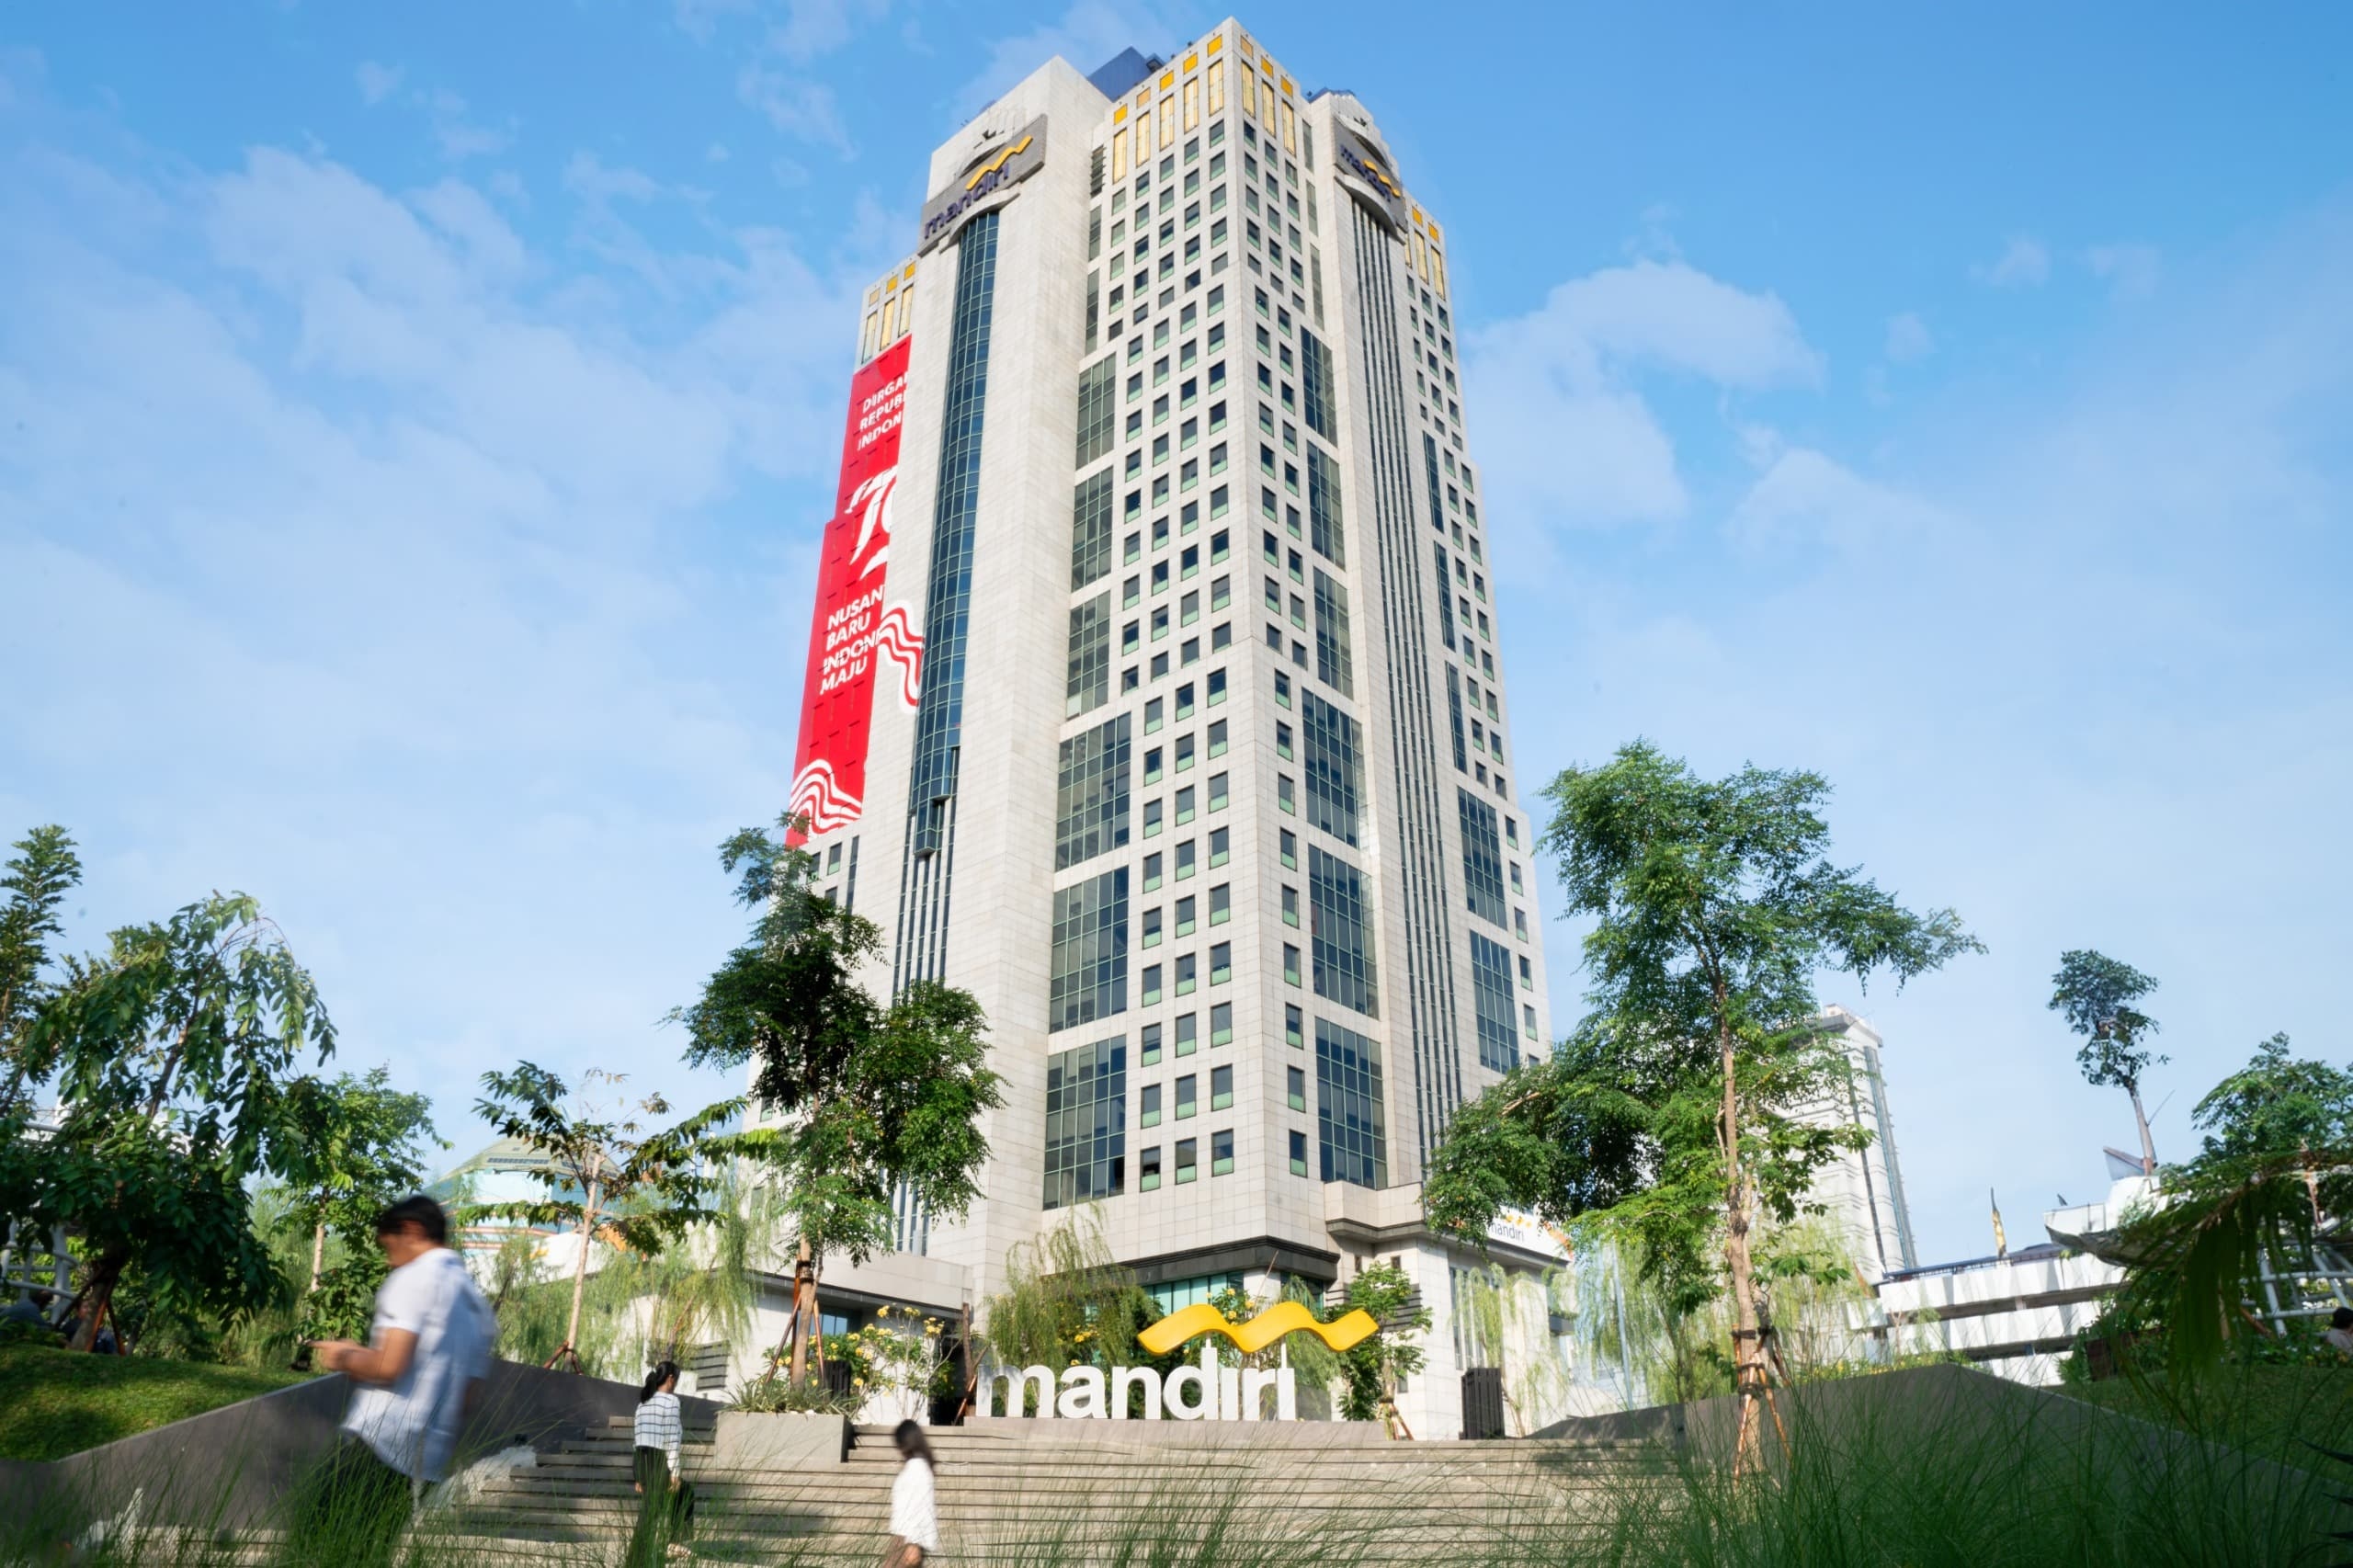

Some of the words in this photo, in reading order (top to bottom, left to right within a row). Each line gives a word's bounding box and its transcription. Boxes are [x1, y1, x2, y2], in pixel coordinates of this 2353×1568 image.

[925, 163, 1009, 240] mandiri
[827, 585, 885, 631] NUSAN
[825, 611, 871, 652] BARU
[819, 655, 868, 695] MAJU
[975, 1346, 1296, 1421] mandiri
